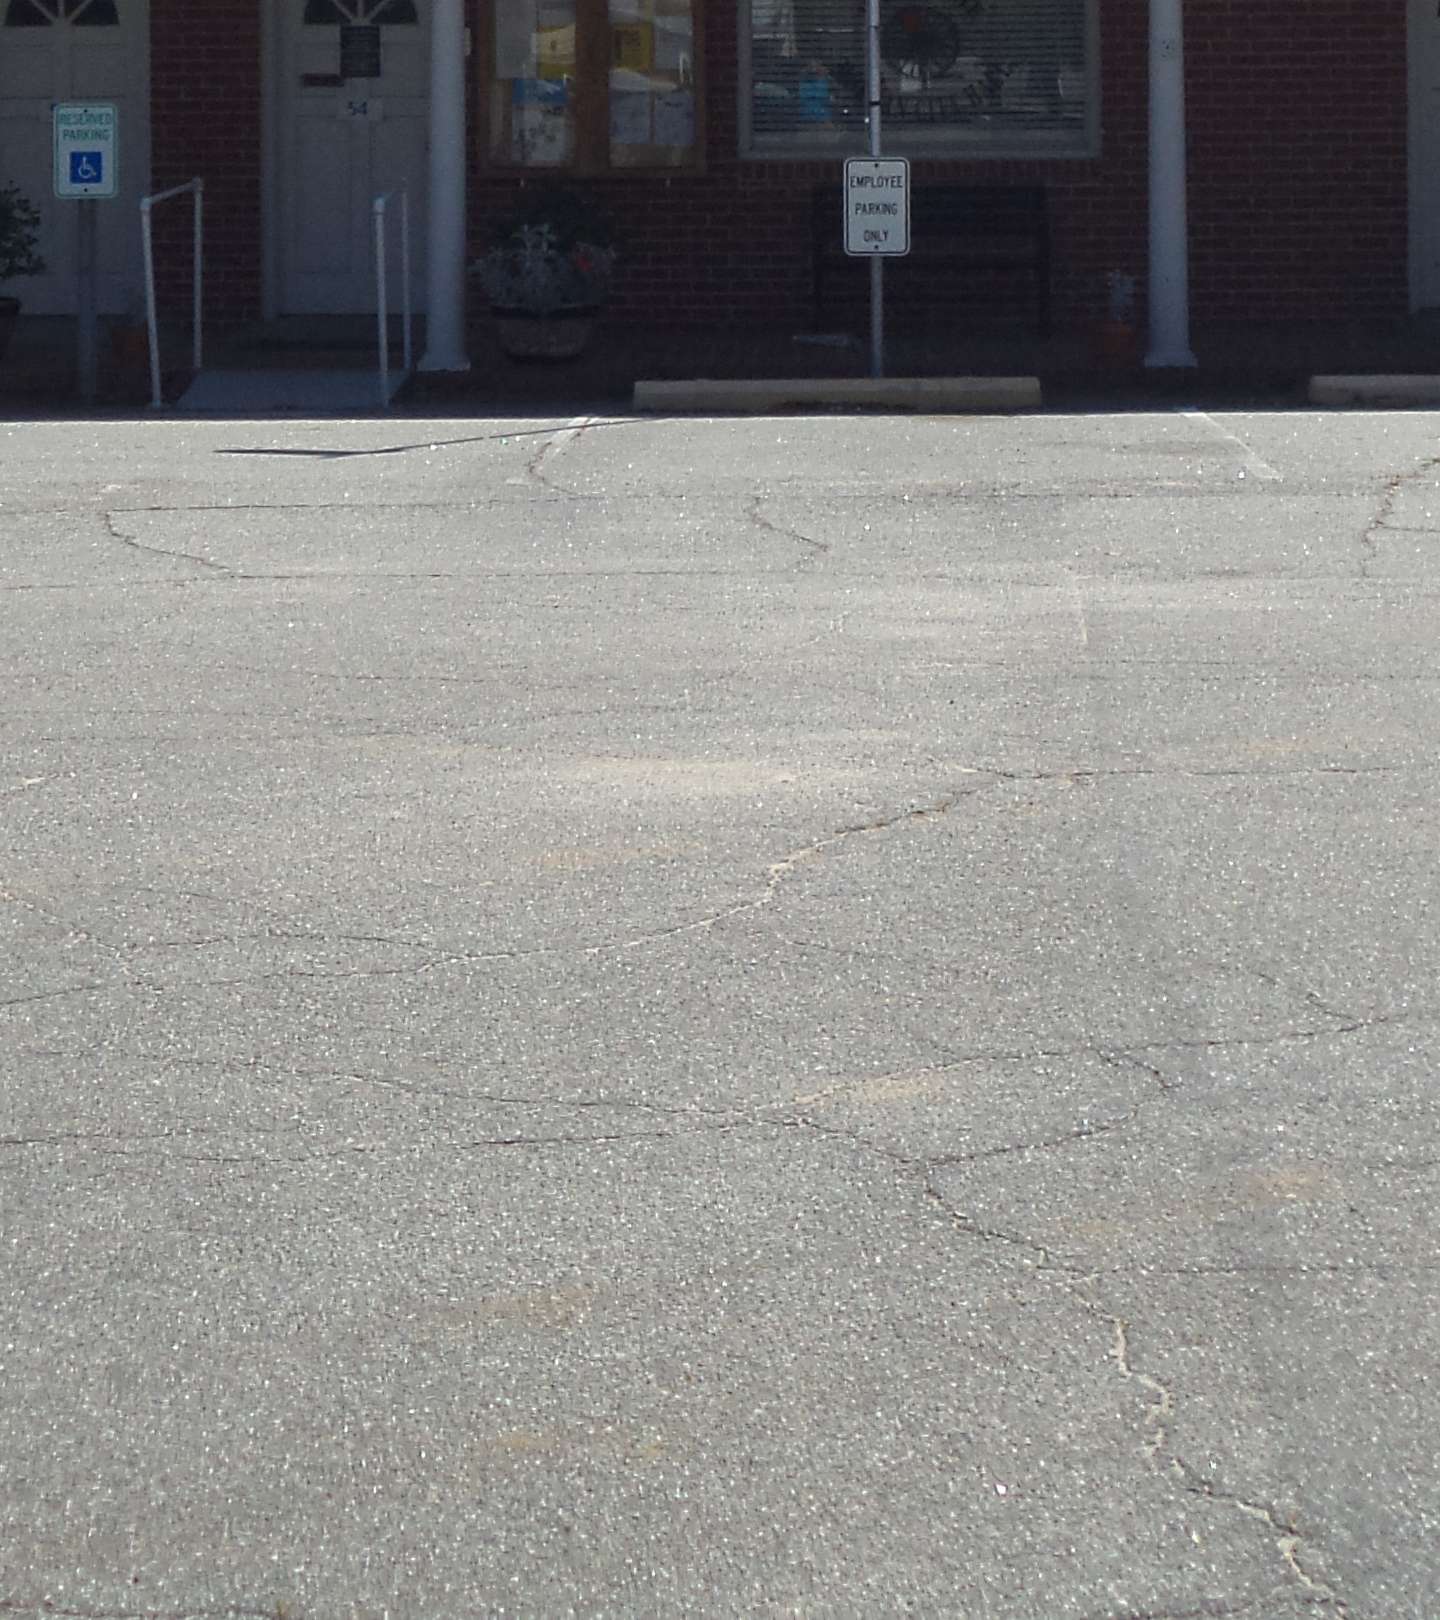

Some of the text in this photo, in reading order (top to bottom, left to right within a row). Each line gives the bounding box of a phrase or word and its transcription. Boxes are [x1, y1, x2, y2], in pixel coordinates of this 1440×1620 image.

[347, 100, 368, 116] 54
[63, 129, 109, 140] PARKING
[850, 175, 903, 188] EMPLOYEE
[855, 203, 898, 215] PARKING
[864, 230, 888, 242] ONLY
